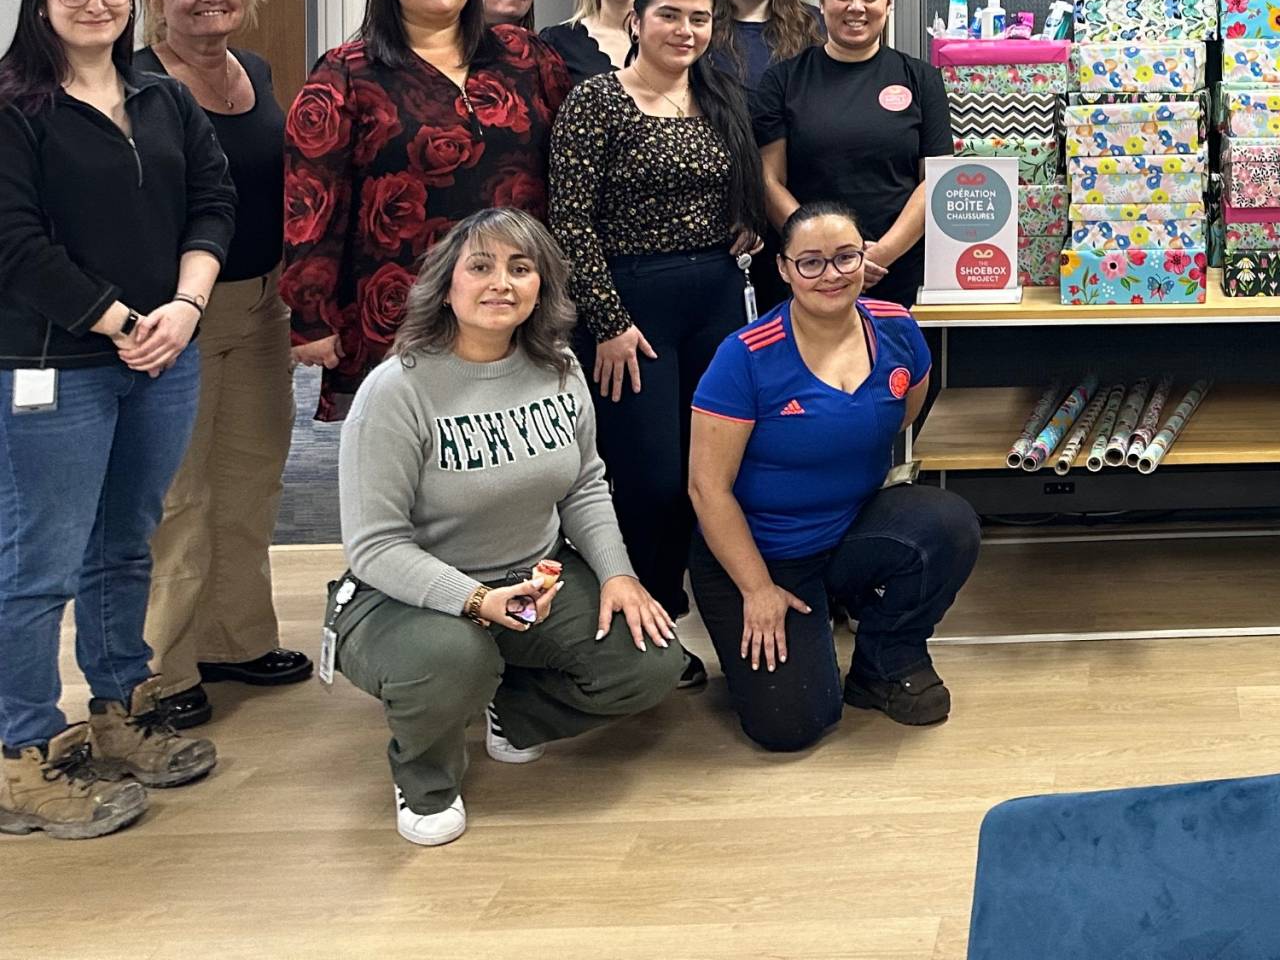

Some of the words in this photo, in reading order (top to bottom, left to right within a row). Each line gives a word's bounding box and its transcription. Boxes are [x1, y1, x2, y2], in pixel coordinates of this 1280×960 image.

[946, 187, 996, 198] OPÉRATION
[947, 198, 983, 211] BOÎTE
[986, 197, 995, 211] À
[960, 266, 1007, 275] SHOEBOX
[435, 413, 515, 471] NEW
[508, 393, 577, 456] YORK
